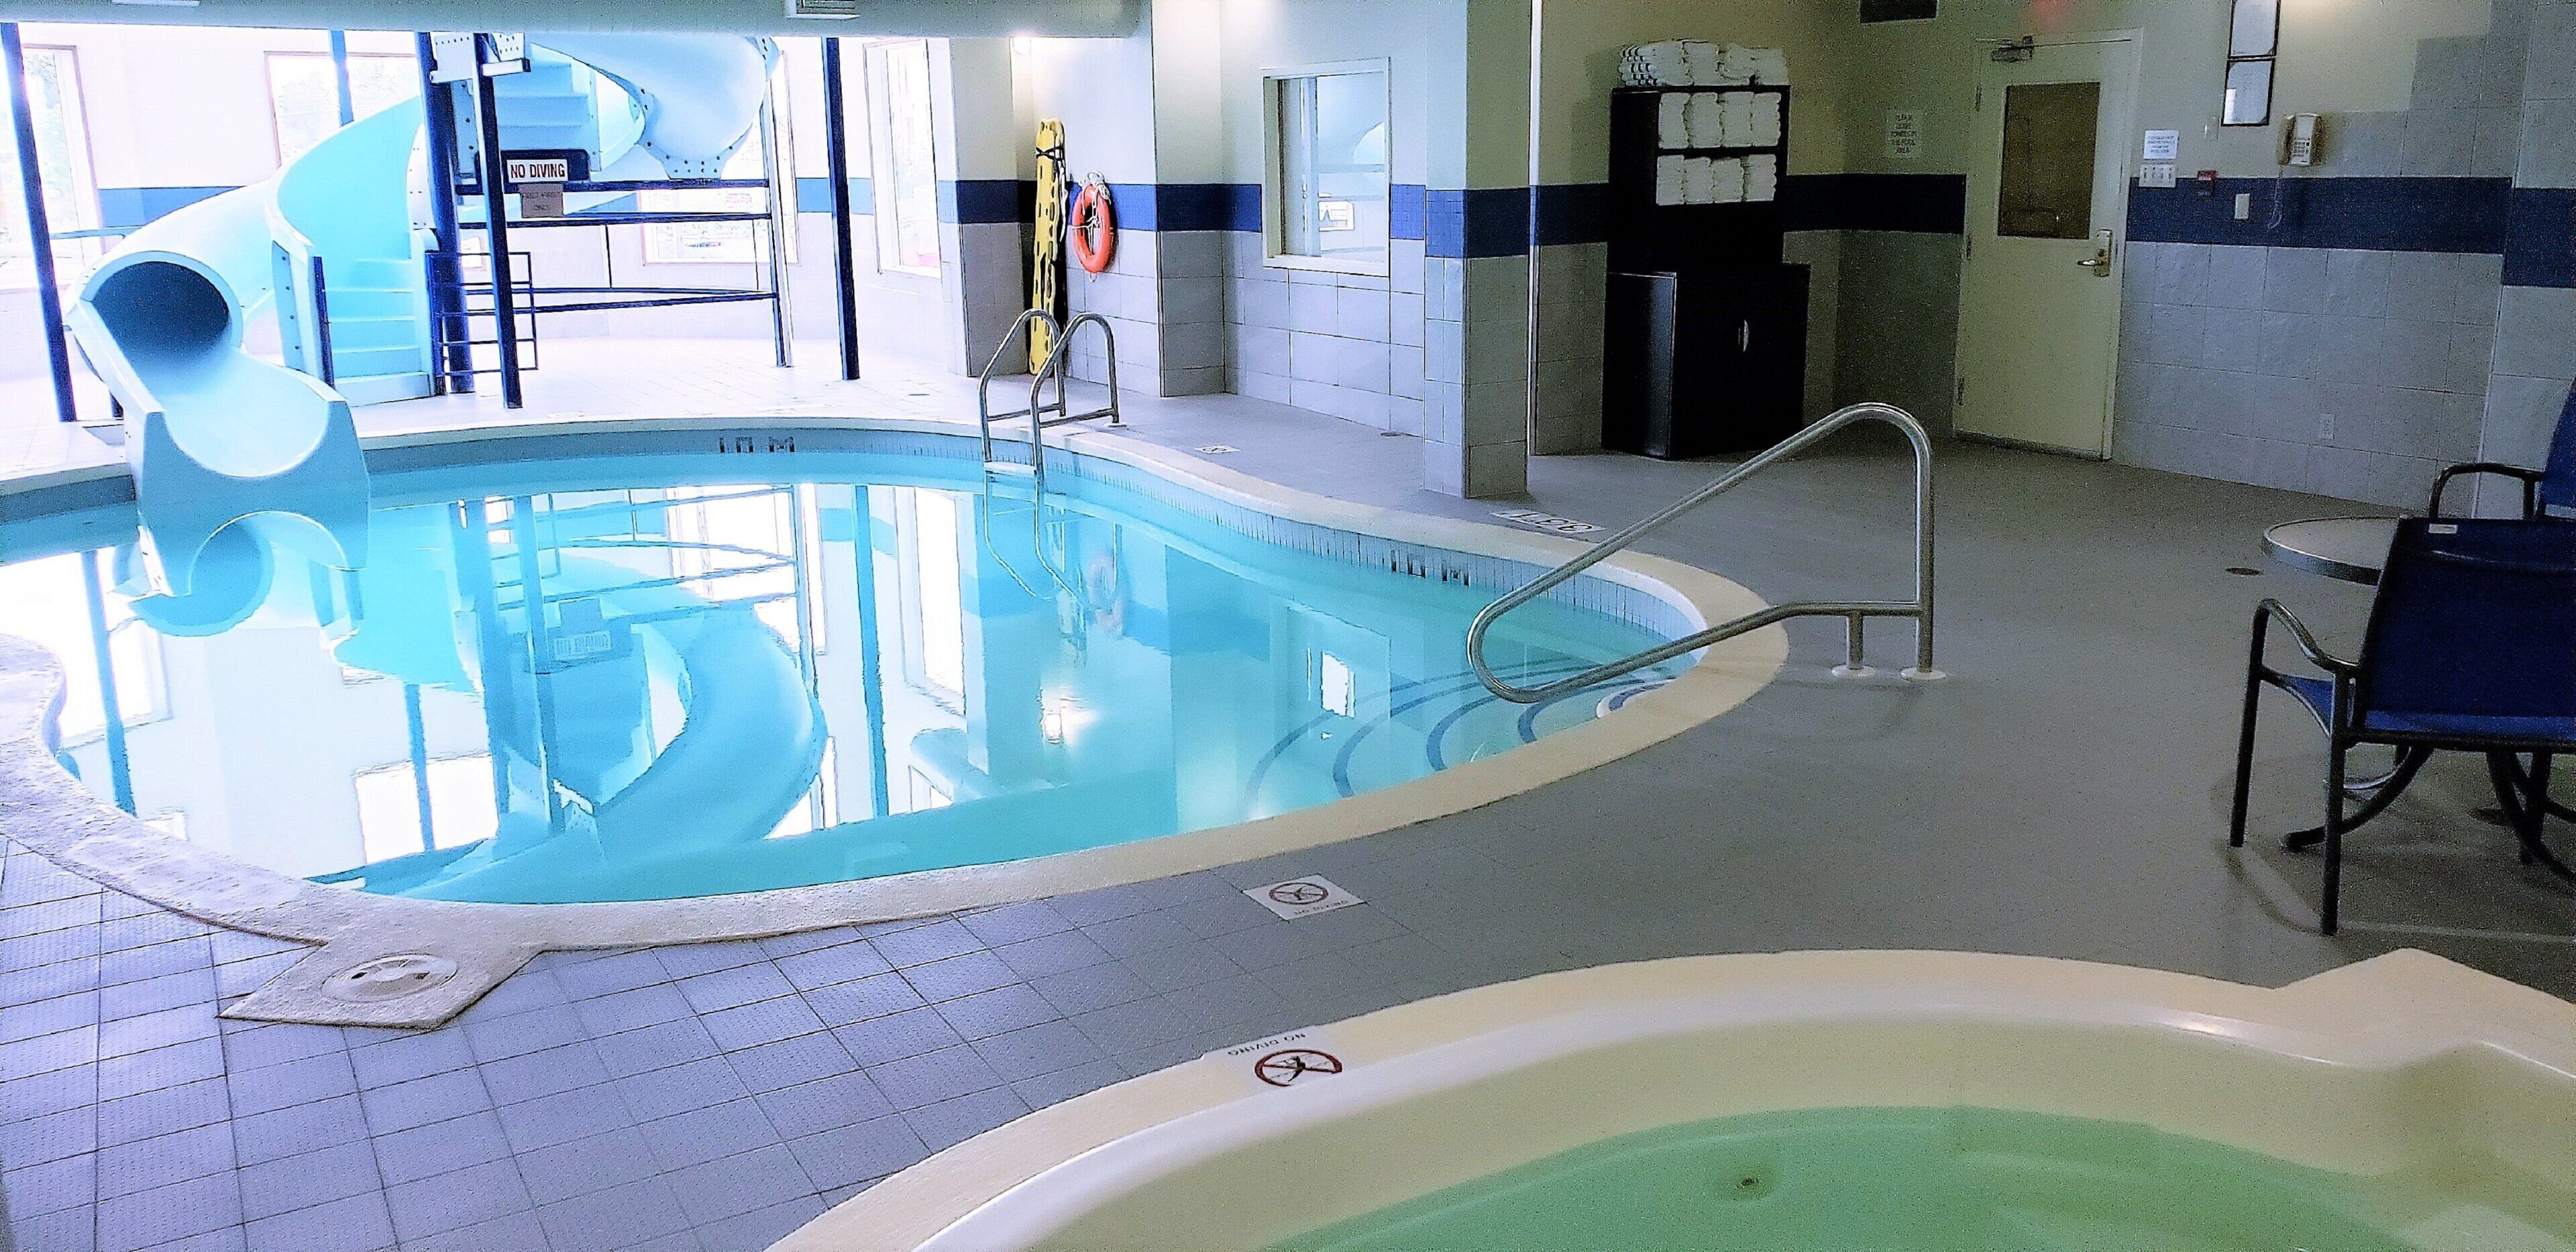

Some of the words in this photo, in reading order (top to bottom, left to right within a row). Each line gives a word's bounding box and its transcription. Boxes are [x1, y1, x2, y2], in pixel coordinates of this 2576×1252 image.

[511, 164, 525, 178] NO
[530, 164, 565, 178] DIVING
[1284, 1033, 1305, 1041] NO
[1228, 1039, 1279, 1055] DIVING
